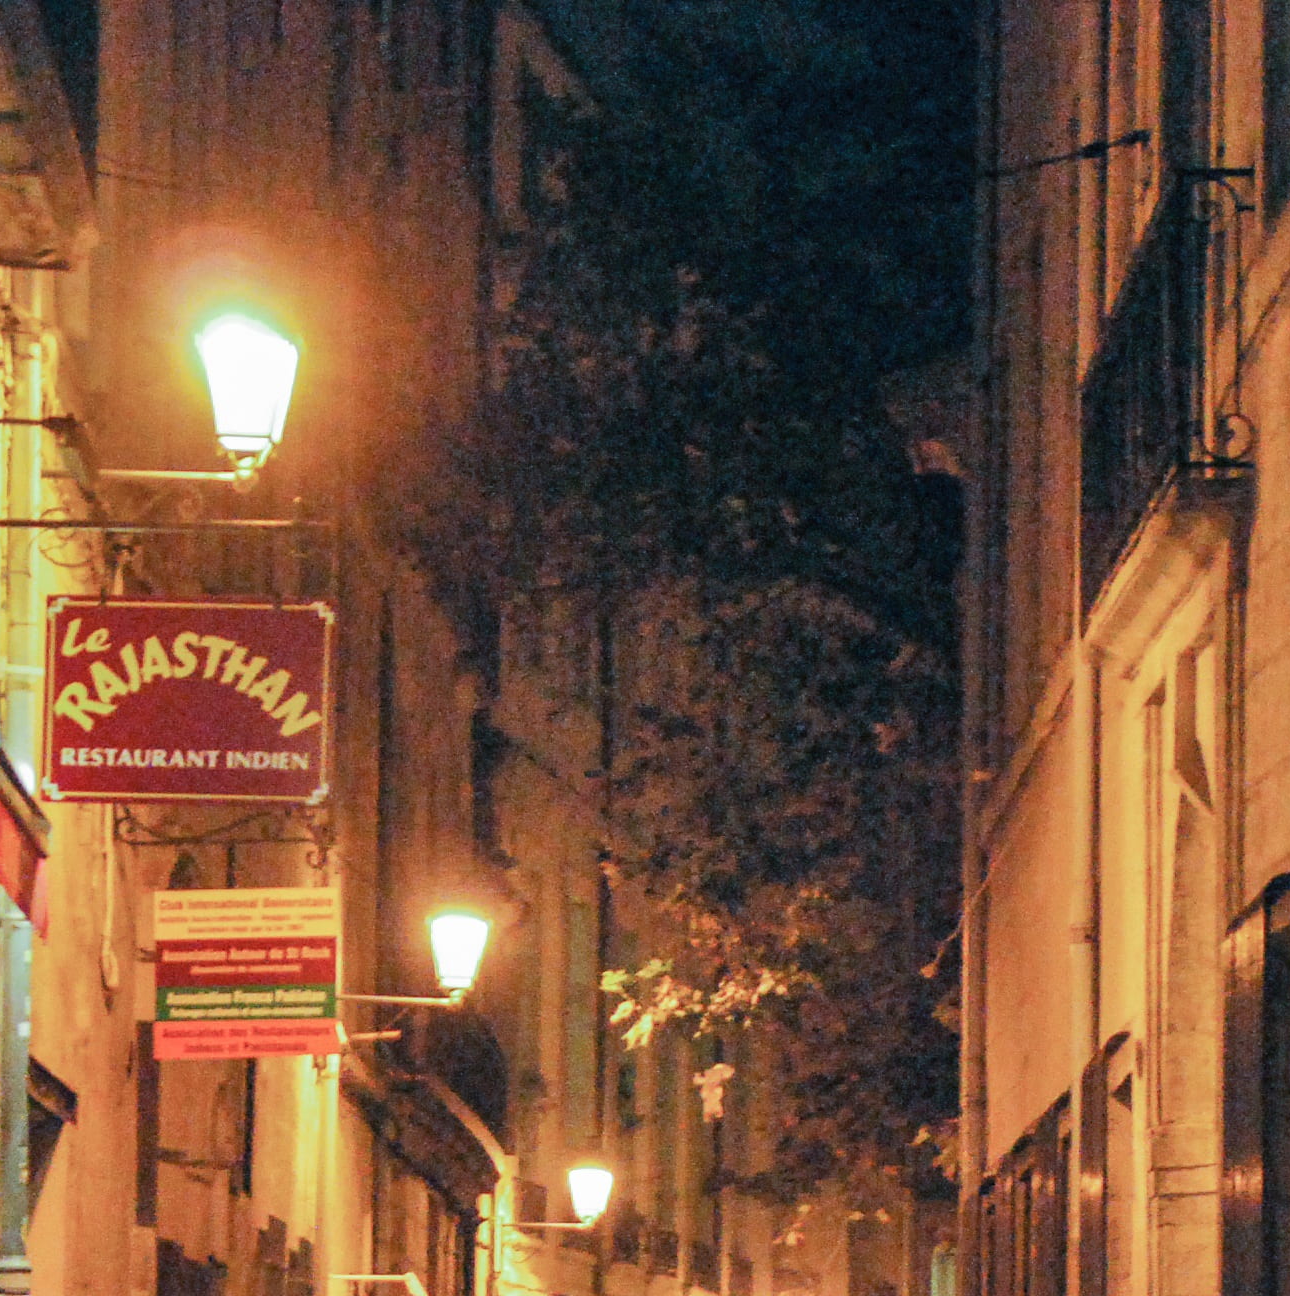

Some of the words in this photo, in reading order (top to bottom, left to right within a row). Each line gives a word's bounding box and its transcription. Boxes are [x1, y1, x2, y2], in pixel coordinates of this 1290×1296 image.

[60, 618, 112, 656] Le
[53, 631, 323, 737] RAJASTHAN
[59, 747, 219, 768] RESTAURANT
[226, 750, 309, 770] INDIEN
